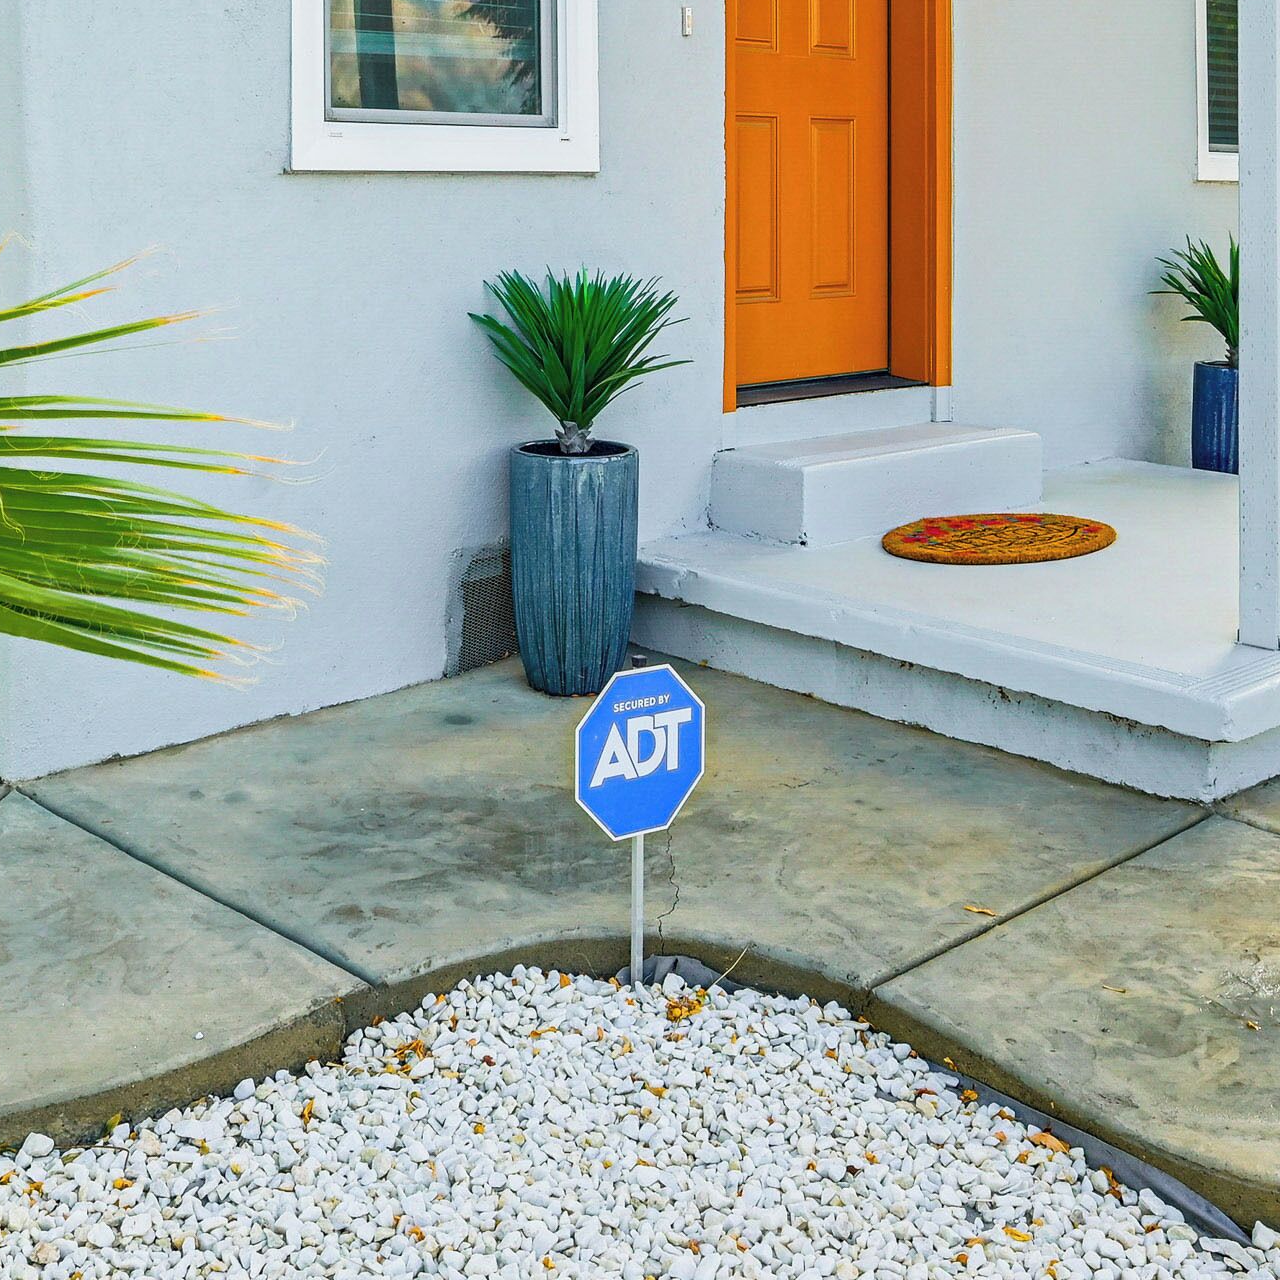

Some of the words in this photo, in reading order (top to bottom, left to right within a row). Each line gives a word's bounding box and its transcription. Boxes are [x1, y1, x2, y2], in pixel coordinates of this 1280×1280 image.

[613, 696, 656, 713] SECURED
[658, 694, 670, 705] BY
[589, 707, 692, 788] ADT
